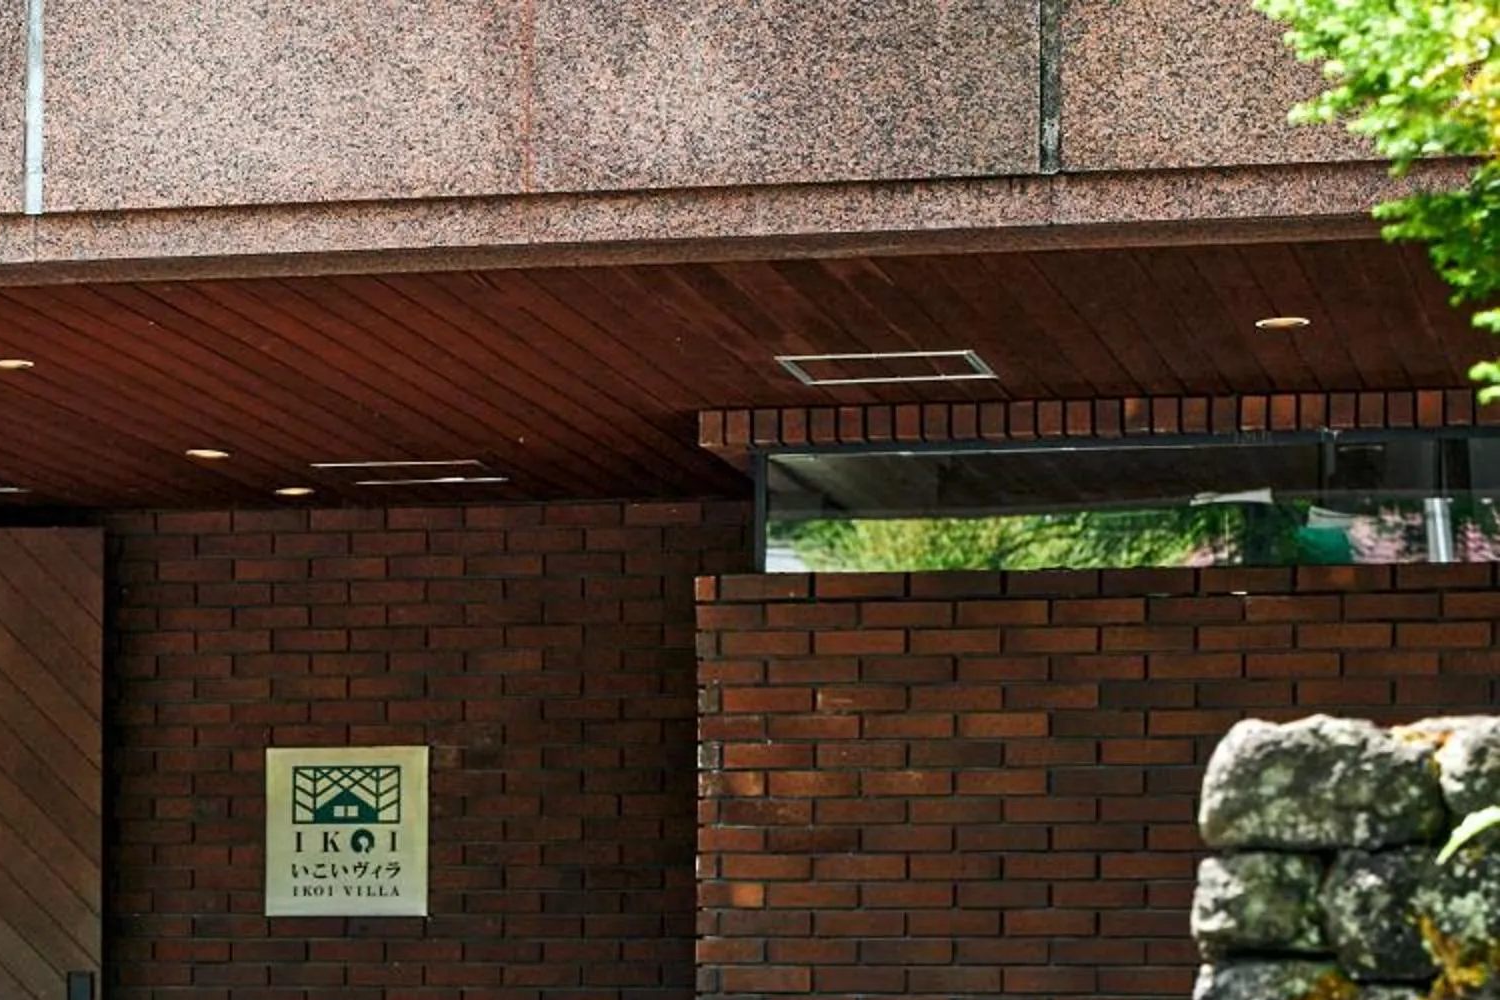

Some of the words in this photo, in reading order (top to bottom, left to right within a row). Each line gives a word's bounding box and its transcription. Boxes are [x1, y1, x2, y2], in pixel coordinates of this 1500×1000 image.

[291, 861, 401, 879] いこいヴィラ
[293, 885, 334, 897] IKOI
[343, 885, 400, 897] VILLA
